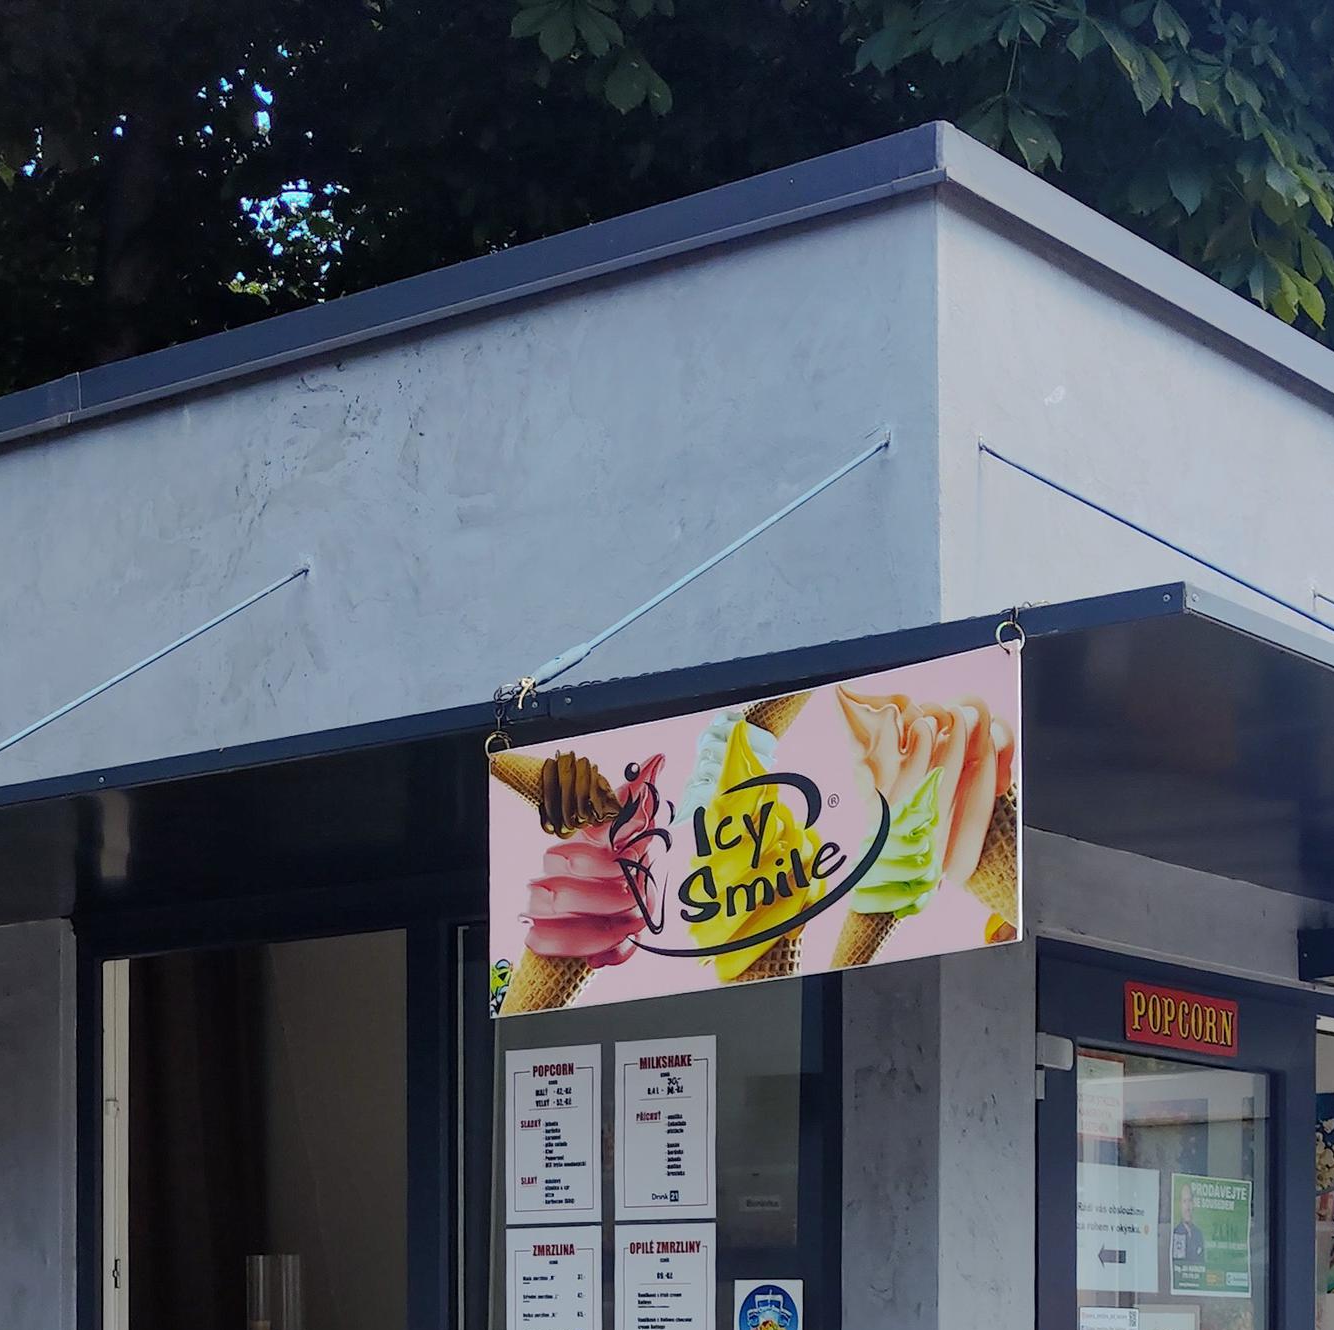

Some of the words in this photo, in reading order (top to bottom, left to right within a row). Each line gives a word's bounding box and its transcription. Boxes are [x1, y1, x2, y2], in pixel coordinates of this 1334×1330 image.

[692, 802, 775, 868] Icy
[679, 841, 846, 924] Smile
[1131, 990, 1234, 1047] POPCORN
[532, 1062, 574, 1078] POPCORN
[639, 1054, 692, 1070] MILKSHAKE
[1191, 1181, 1248, 1201] PRODÁVEJTE
[532, 1243, 575, 1257] ZMRZLINA
[629, 1239, 654, 1254] OPILÉ
[656, 1240, 701, 1254] ZMRZLINY
